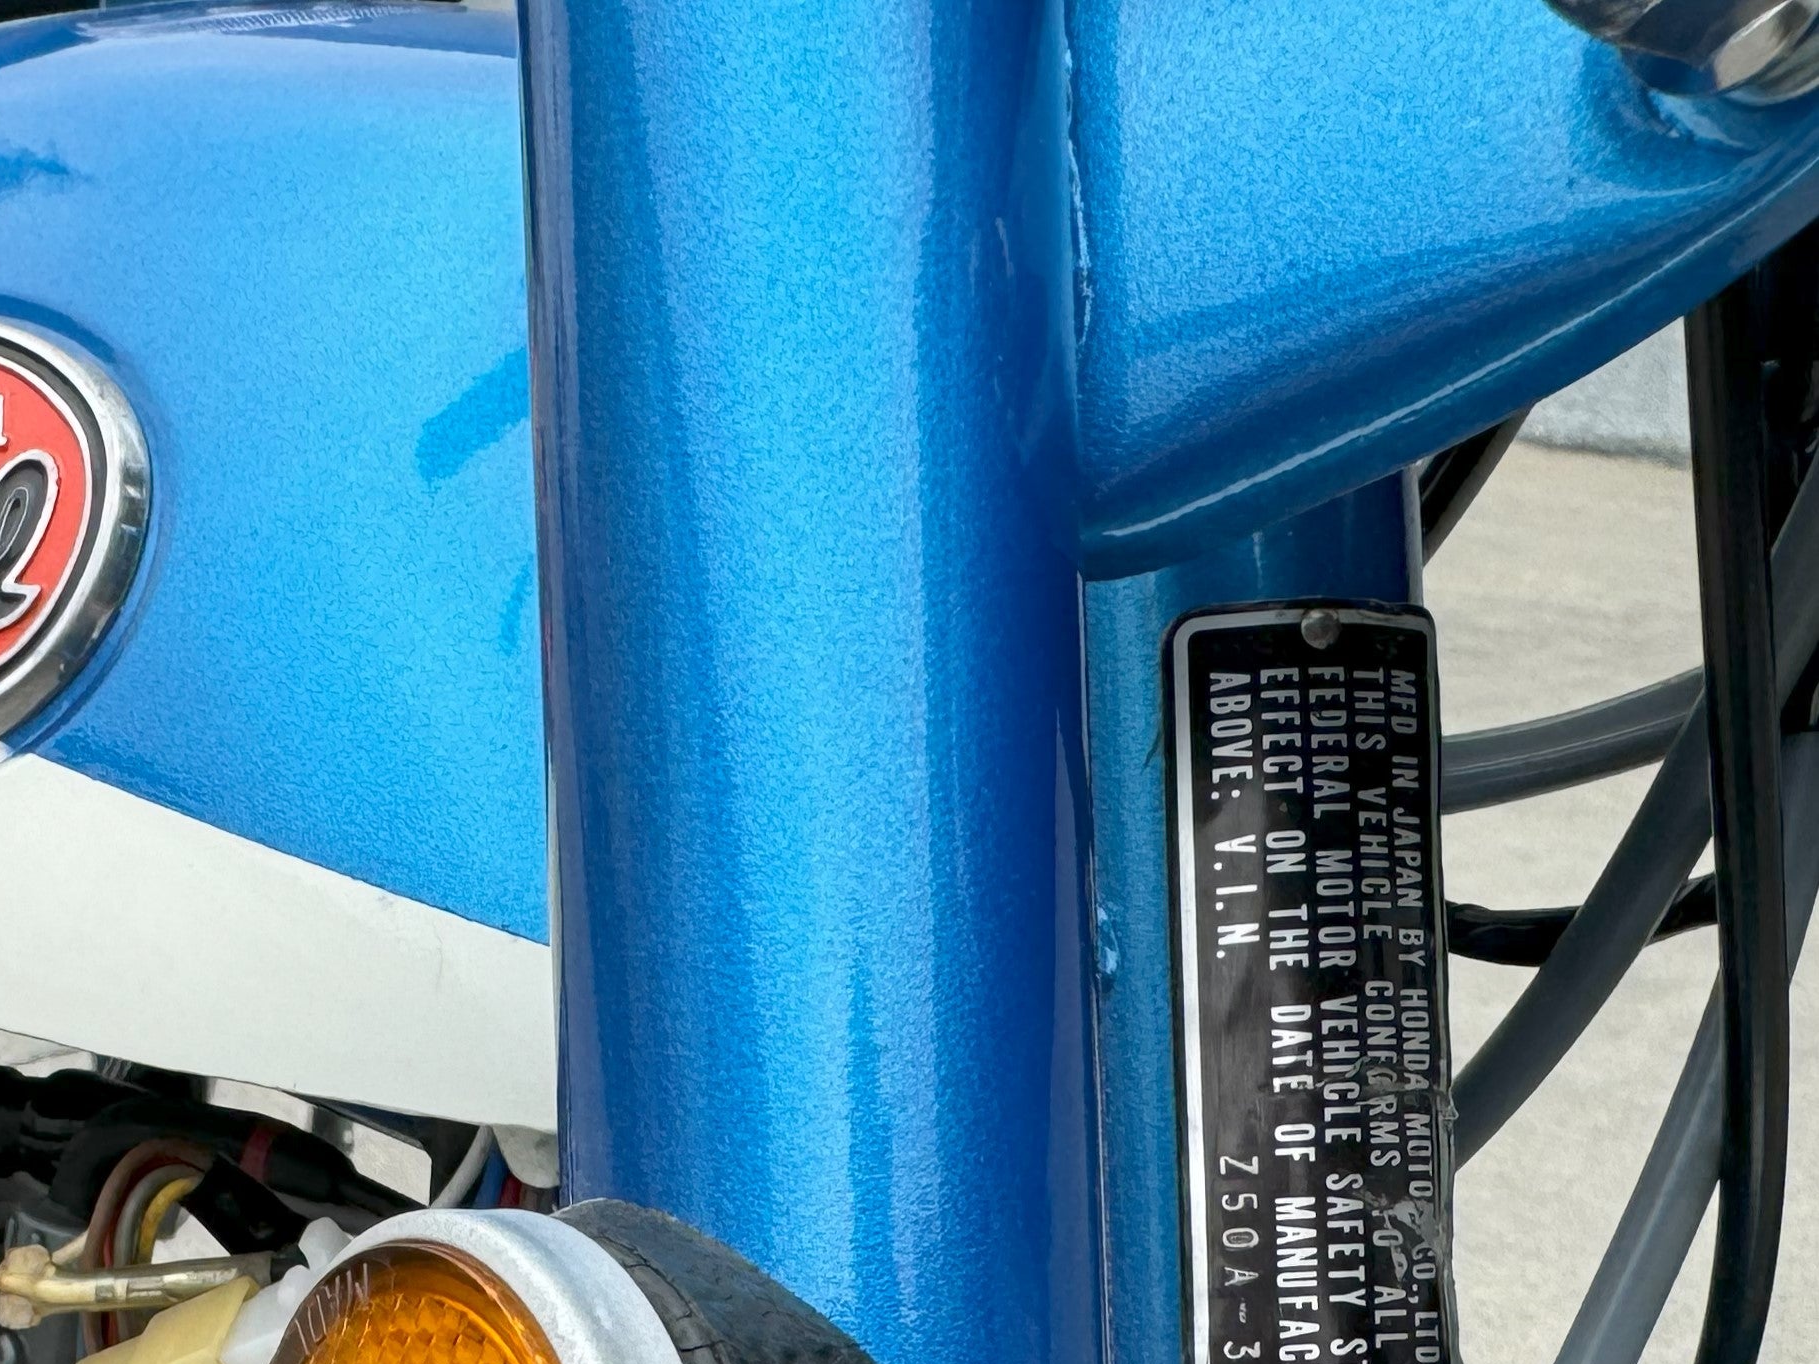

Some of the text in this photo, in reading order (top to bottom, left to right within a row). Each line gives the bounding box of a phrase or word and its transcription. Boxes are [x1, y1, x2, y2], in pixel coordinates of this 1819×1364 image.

[1208, 671, 1255, 801] ABOVE:
[1259, 667, 1305, 795] EFFECT
[1307, 665, 1352, 820] FEDERAL
[1352, 667, 1388, 752] THIS
[1389, 668, 1419, 735] MFD
[1391, 754, 1421, 789] IN
[1264, 829, 1308, 875] ON
[1356, 787, 1394, 941] VEHICLE
[1391, 806, 1424, 908] JAPAN
[1267, 903, 1310, 972] THE
[1314, 848, 1358, 970] MOTOR
[1397, 927, 1427, 968] BY
[1269, 1003, 1316, 1094] DATE
[1319, 994, 1363, 1145] VEHICLE
[1363, 979, 1403, 1168] CONFORMS
[1398, 988, 1432, 1091] HONDA
[1273, 1122, 1318, 1163] OF
[1402, 1112, 1434, 1221] MOTO
[1325, 1172, 1367, 1308] SAFETY
[1372, 1285, 1410, 1350] ALL
